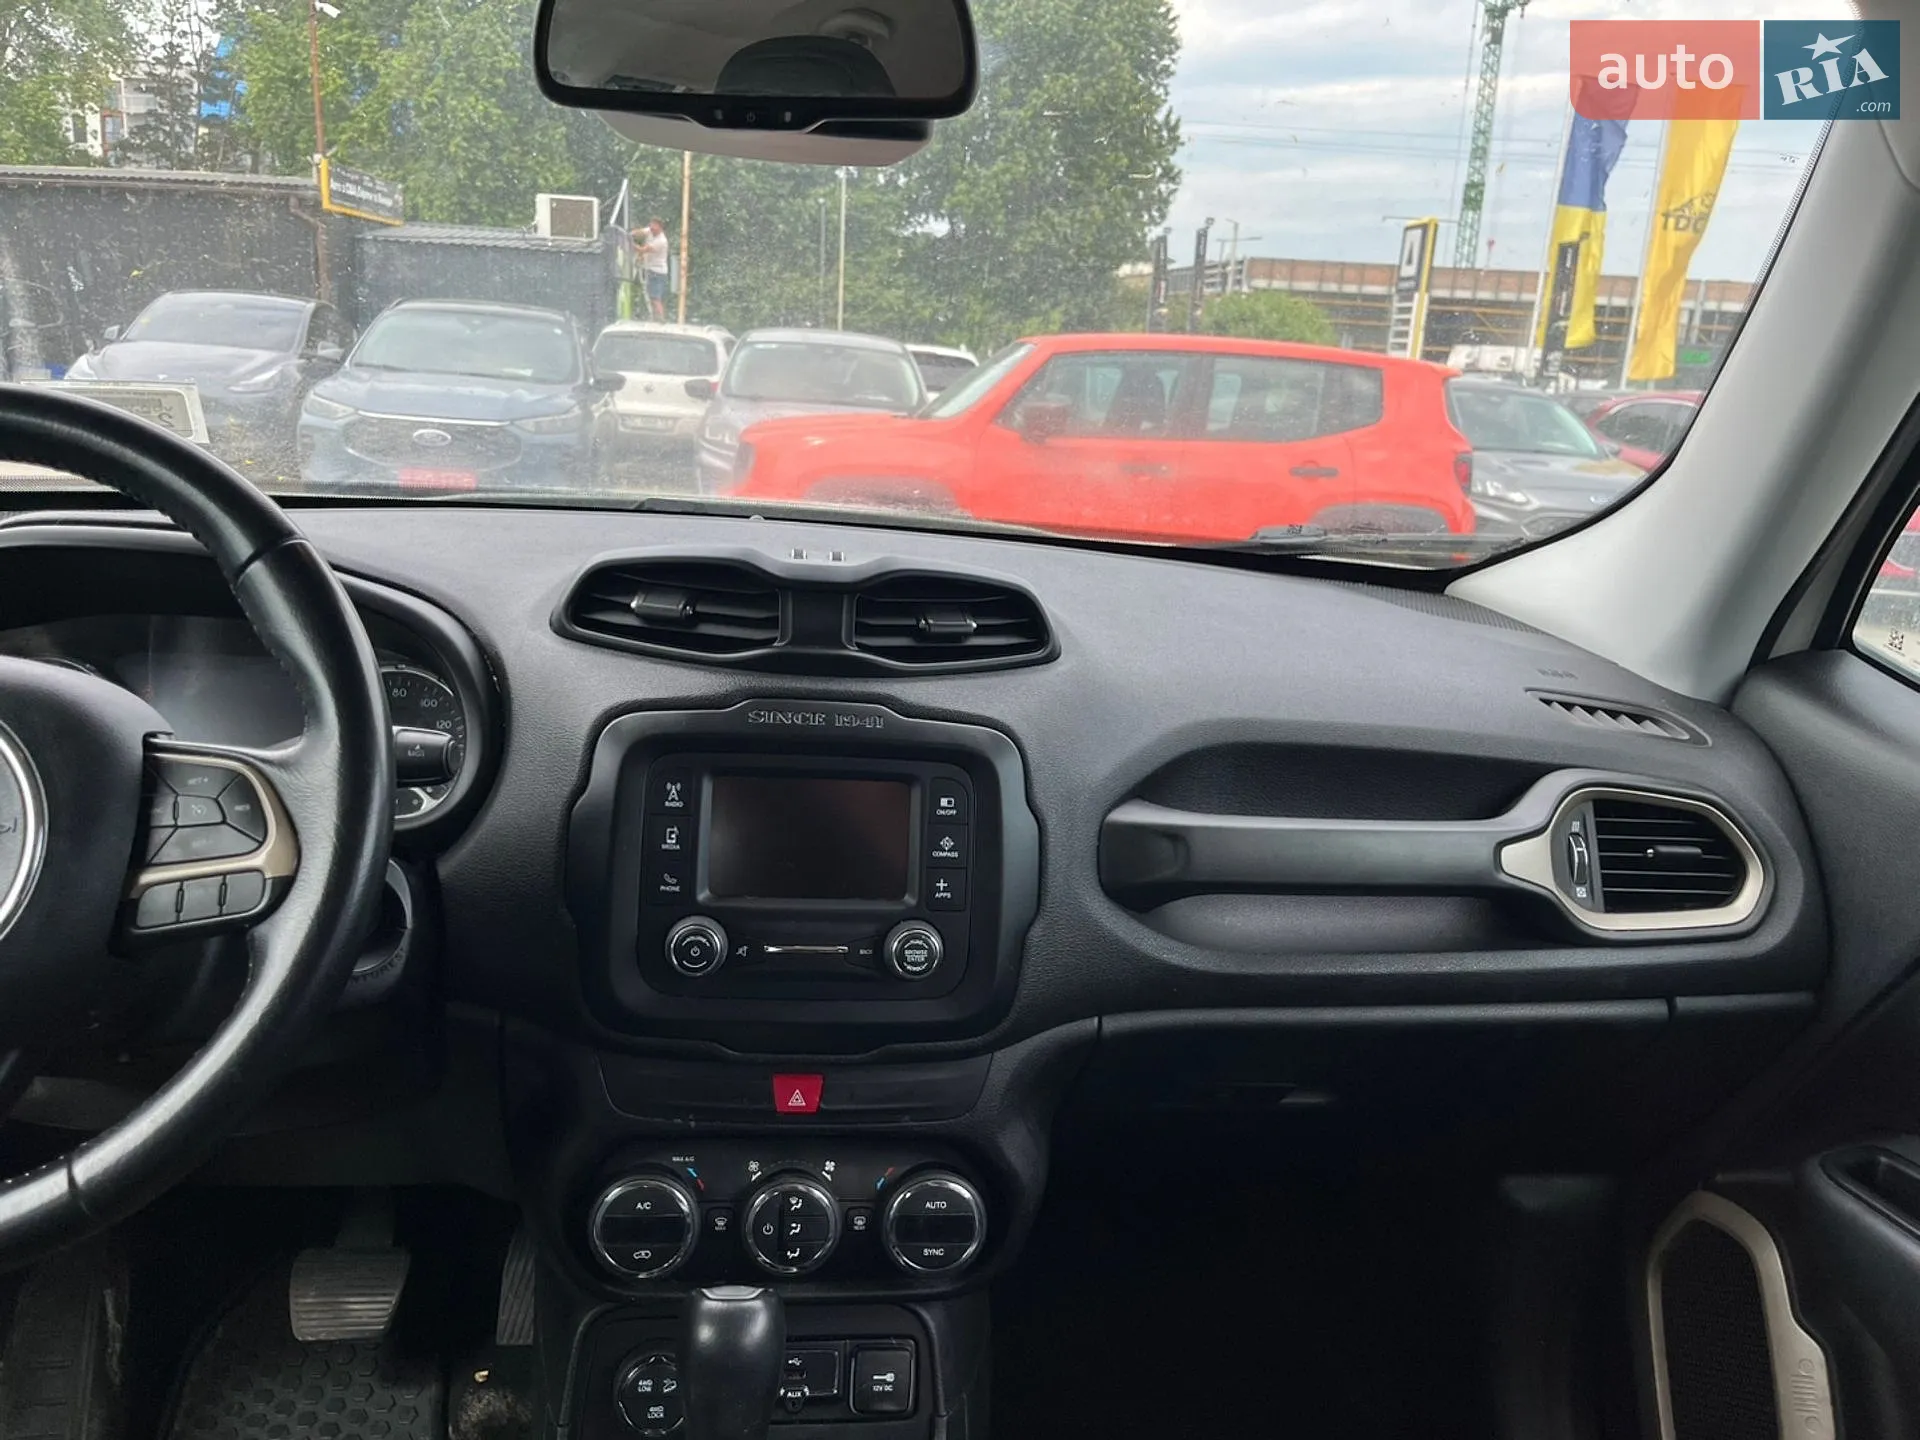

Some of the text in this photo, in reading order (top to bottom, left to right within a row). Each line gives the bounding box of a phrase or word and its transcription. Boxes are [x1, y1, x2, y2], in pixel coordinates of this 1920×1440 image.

[392, 688, 407, 697] 80
[421, 699, 438, 708] 100
[748, 710, 885, 729] SINCE 1941
[436, 719, 452, 730] 120
[936, 808, 957, 816] ON/OFF
[932, 850, 959, 859] COMPASS
[660, 885, 681, 893] PHONE
[636, 1201, 652, 1210] A/C
[925, 1201, 947, 1209] AUTO
[923, 1248, 945, 1256] SYNC
[647, 1411, 664, 1419] LOCK
